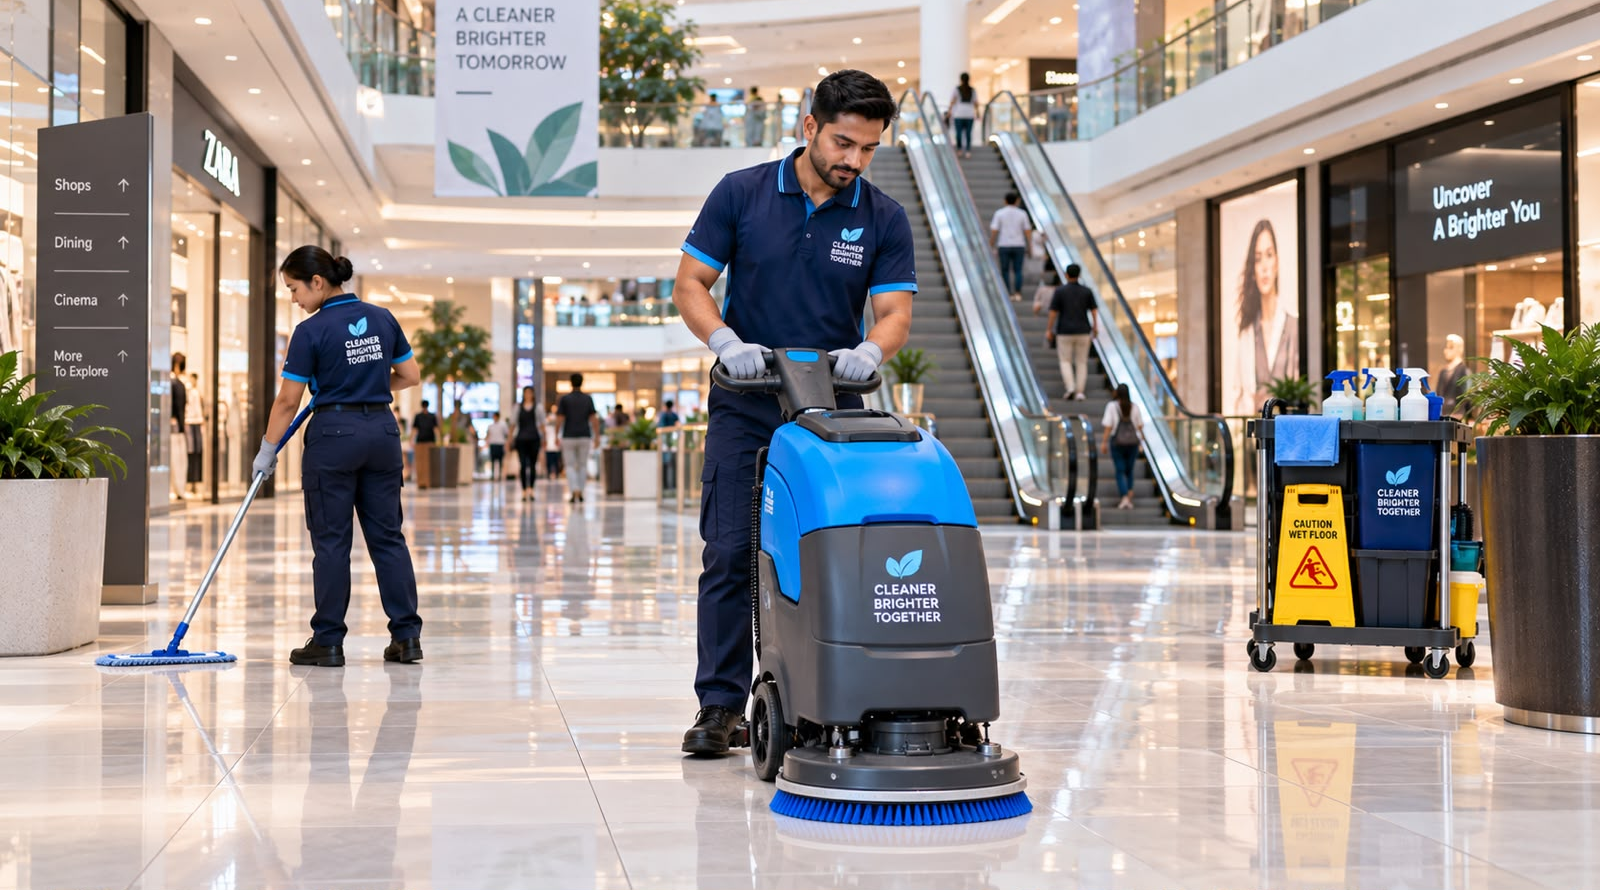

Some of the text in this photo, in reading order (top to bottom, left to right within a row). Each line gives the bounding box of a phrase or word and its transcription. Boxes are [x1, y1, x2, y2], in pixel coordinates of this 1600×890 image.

[455, 7, 555, 22] A CLEANER
[456, 30, 546, 46] BRIGHTER
[455, 54, 567, 70] TOMORROW
[203, 129, 240, 197] ZARA
[54, 178, 92, 194] Shops
[1433, 179, 1493, 210] Uncover
[1433, 199, 1541, 241] A Brighter You
[54, 236, 93, 252] Dining
[53, 293, 98, 306] Cinema
[344, 335, 380, 349] CLEANER
[53, 350, 83, 362] More
[53, 365, 109, 380] To Explore
[1377, 488, 1419, 498] CLEANER
[1377, 498, 1420, 507] BRIGHTER
[1377, 507, 1421, 516] TOGETHER
[1293, 519, 1333, 529] CAUTION
[1288, 530, 1338, 540] WET FLOOR
[874, 583, 937, 596] CLEANER
[874, 597, 940, 610] BRIGHTER
[873, 611, 942, 623] TOGETHER
